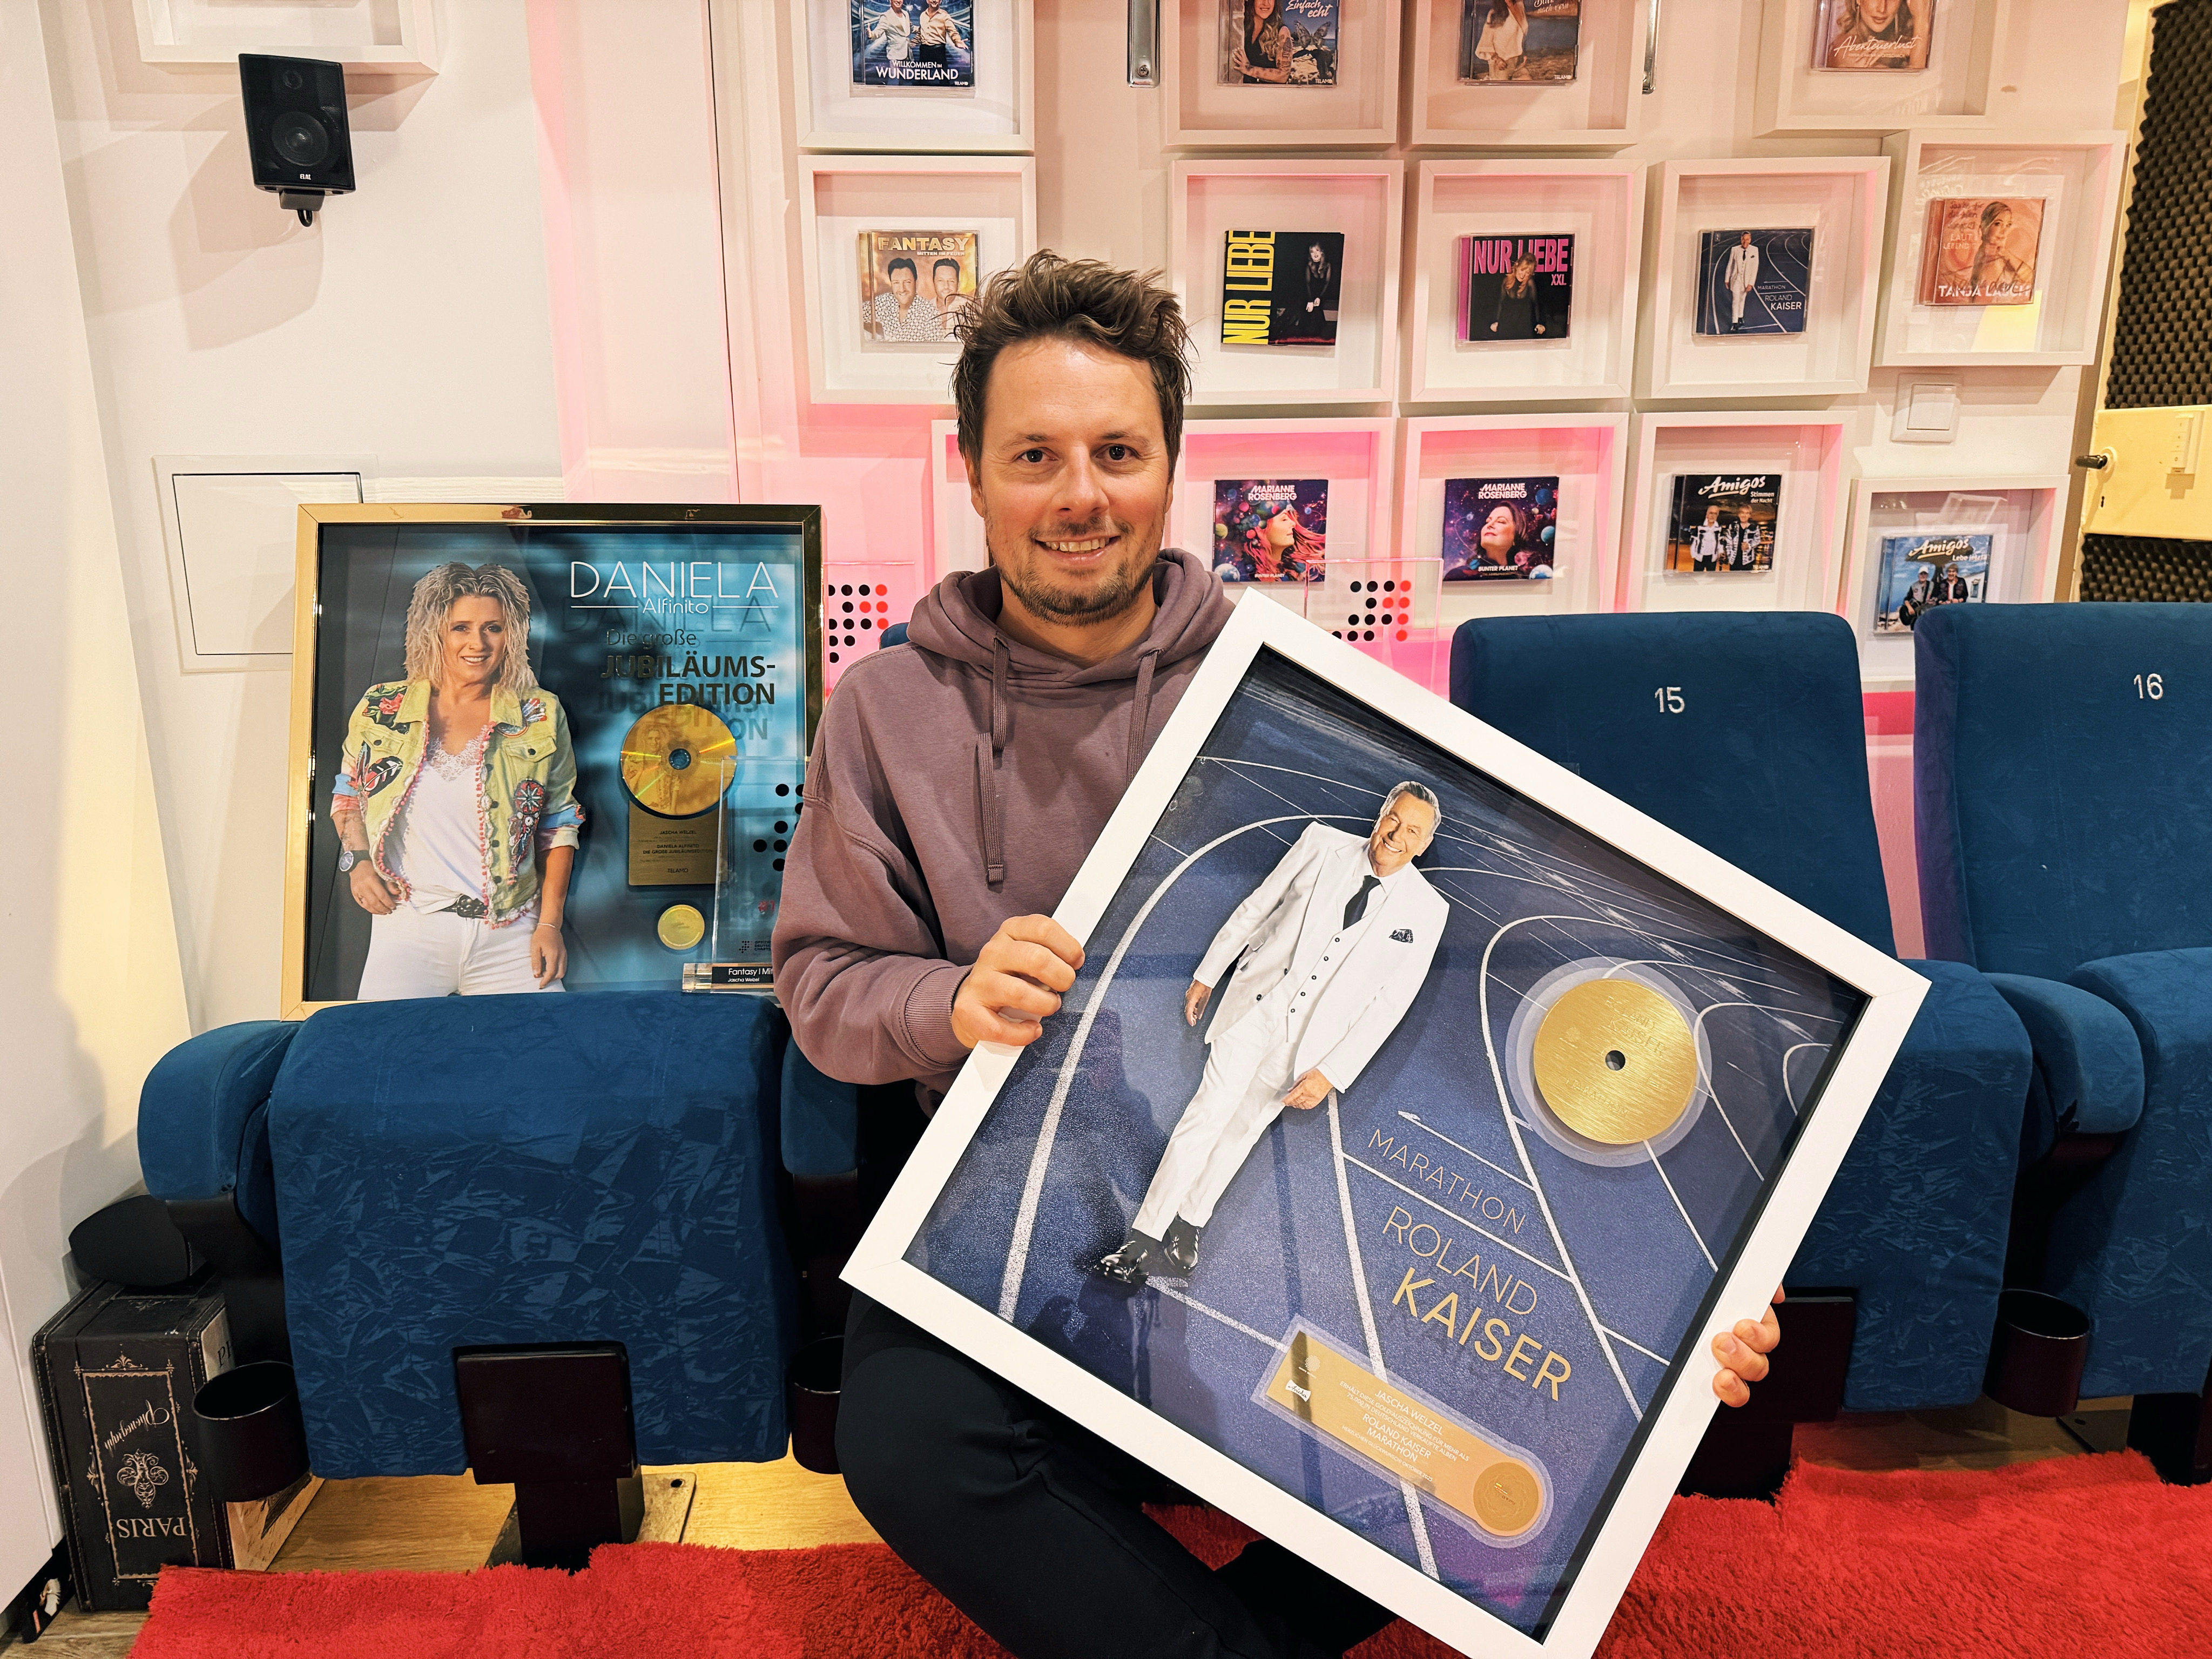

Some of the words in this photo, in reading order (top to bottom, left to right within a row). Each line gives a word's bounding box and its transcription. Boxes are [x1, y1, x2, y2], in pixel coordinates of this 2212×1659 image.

[1307, 4, 1333, 18] echt
[1833, 35, 1923, 59] Abenteuerlust
[875, 66, 959, 80] WUNDERLAND
[892, 60, 936, 69] WILLKOMMEN
[878, 237, 969, 251] FANTASY
[1225, 231, 1276, 291] LIEBE
[1474, 240, 1512, 274] NUR
[1551, 274, 1567, 286] XXL
[1770, 301, 1802, 311] KAISER
[1223, 299, 1271, 345] NUR
[1248, 492, 1297, 501] ROSENBERG
[1250, 485, 1296, 494] MARIANNE
[1478, 490, 1528, 500] ROSENBERG
[1481, 483, 1526, 492] MARIANNE
[1698, 476, 1766, 496] Amigos
[1908, 538, 1970, 557] Amigos
[570, 560, 779, 598] DANIELA
[643, 597, 709, 615] Alfinito
[606, 629, 637, 646] Die
[601, 650, 775, 679] JUBILÄUMS-
[659, 683, 775, 705] EDITION
[2134, 673, 2163, 700] 16
[1655, 686, 1685, 713] 15
[729, 968, 757, 976] Fantasy
[1368, 1129, 1526, 1234] MARATHON
[1382, 1205, 1537, 1315] ROLAND
[1392, 1267, 1571, 1401] KAISER
[1374, 1388, 1411, 1414] JASCHA
[1408, 1409, 1445, 1435] WELZEL
[1359, 1392, 1375, 1404] DIESE
[1442, 1442, 1459, 1455] MEHR
[1458, 1452, 1469, 1461] ALS
[1362, 1413, 1400, 1440] ROLAND
[1400, 1435, 1432, 1459] KAISER
[1370, 1407, 1409, 1432] DEUTSCHLAND
[1409, 1430, 1439, 1451] VERKAUFTE
[1439, 1448, 1457, 1461] ALBEN
[1366, 1426, 1418, 1461] MARATHON
[1401, 1461, 1422, 1475] OKTOBER
[1421, 1473, 1433, 1482] 2025
[116, 1517, 187, 1539] PARIS
